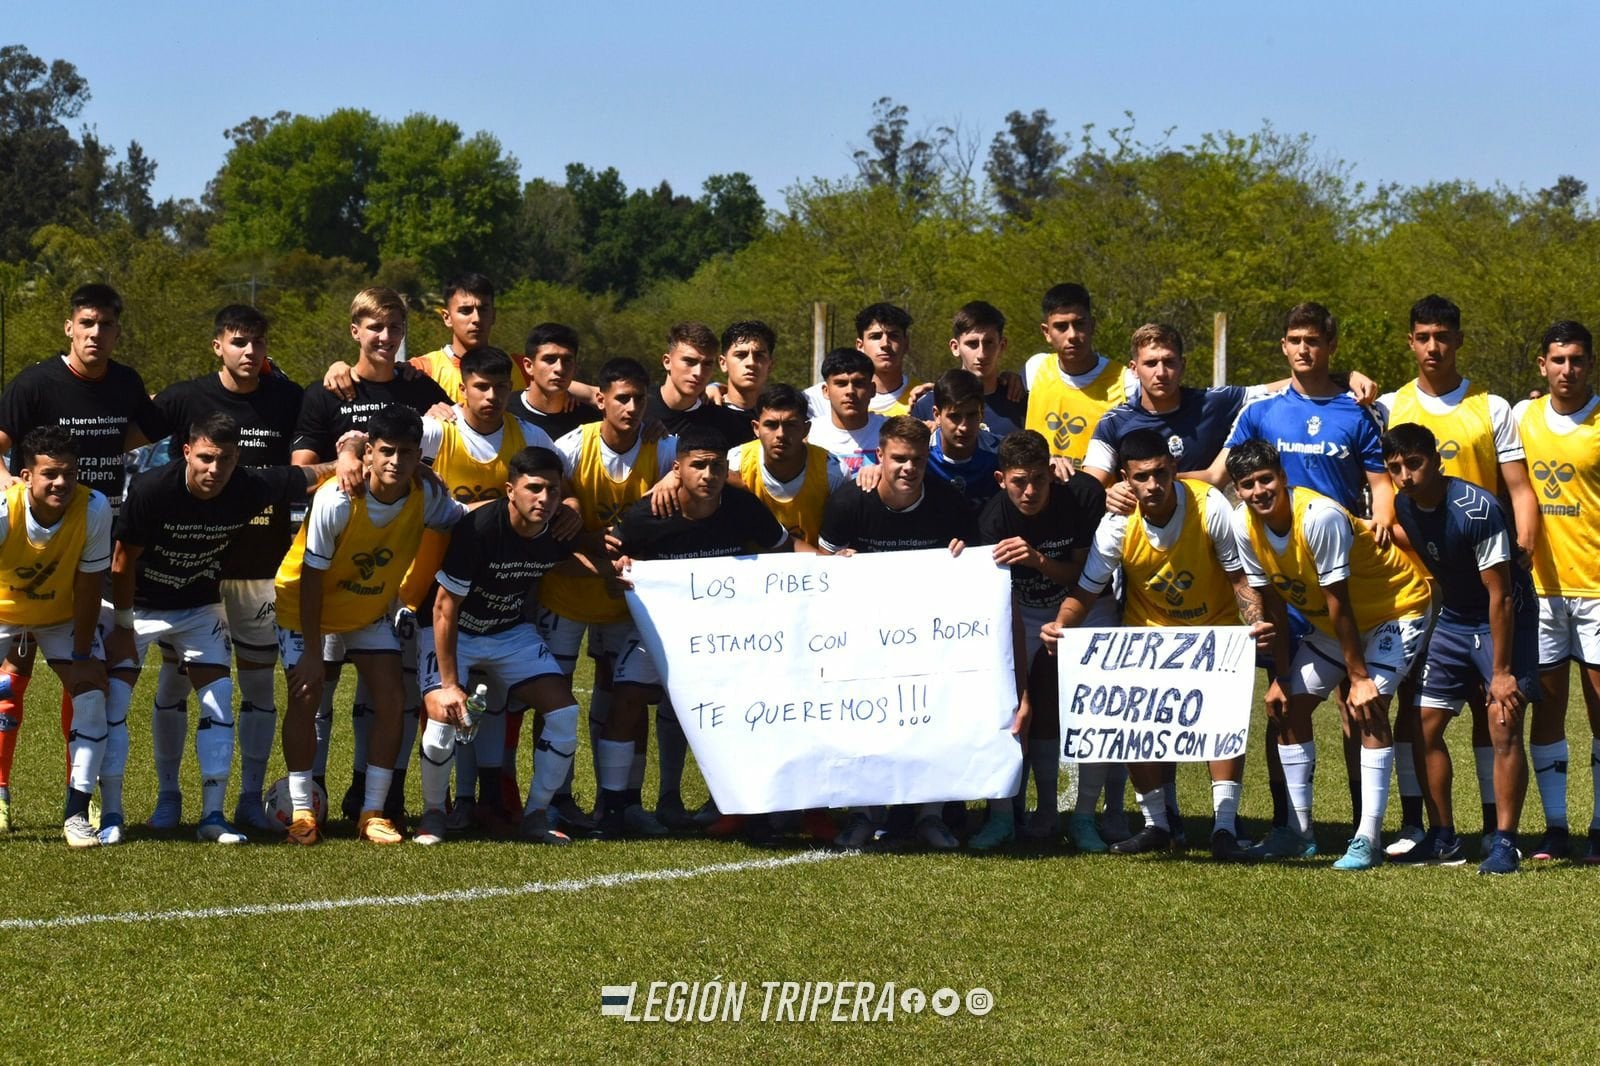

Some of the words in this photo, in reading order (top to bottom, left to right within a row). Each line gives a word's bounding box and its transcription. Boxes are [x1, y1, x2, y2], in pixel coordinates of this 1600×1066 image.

[340, 406, 352, 414] No
[353, 403, 380, 412] fueron
[352, 415, 367, 423] Fue
[71, 417, 97, 425] fueron
[70, 428, 85, 436] Fue
[1276, 438, 1325, 454] hummel
[163, 523, 175, 531] No
[176, 523, 203, 531] fueron
[691, 572, 736, 600] LOS
[690, 631, 783, 654] ESTAMOS
[808, 632, 847, 652] CON
[879, 627, 917, 646] VOS
[1080, 629, 1249, 674] FUERZA!!!
[691, 701, 726, 729] TE
[745, 684, 931, 732] QUEREMOS!!!
[1070, 683, 1204, 727] RODRIGO
[1064, 728, 1172, 760] ESTAMOS
[1174, 730, 1207, 758] CON
[1214, 728, 1246, 756] VOS
